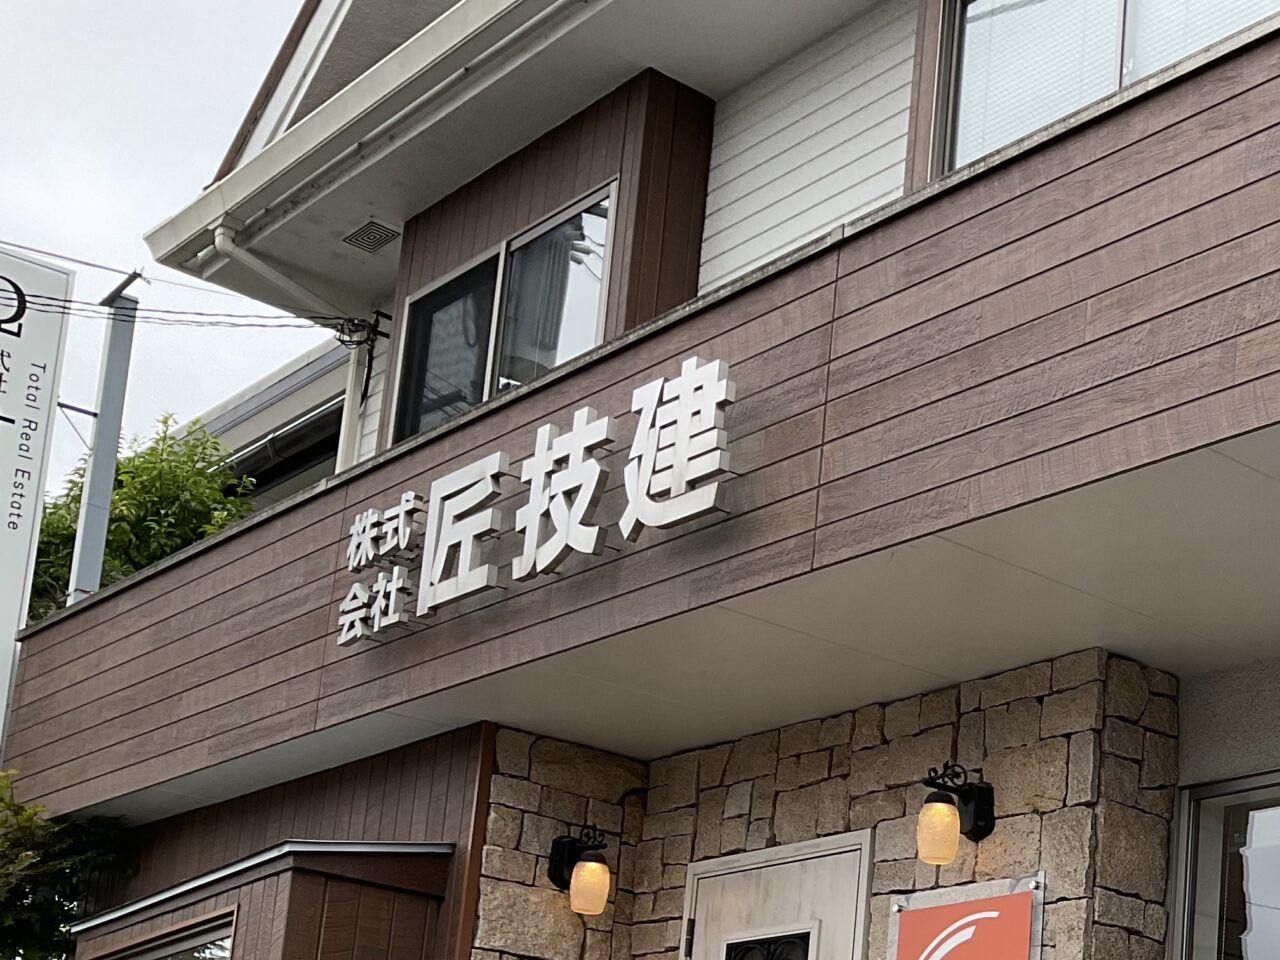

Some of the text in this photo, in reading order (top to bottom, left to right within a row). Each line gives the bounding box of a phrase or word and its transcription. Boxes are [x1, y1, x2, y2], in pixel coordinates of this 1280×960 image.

[7, 361, 47, 532] Total Real Estate
[416, 356, 737, 618] 匠技建
[346, 490, 423, 572] 株式
[337, 566, 411, 646] 会社
